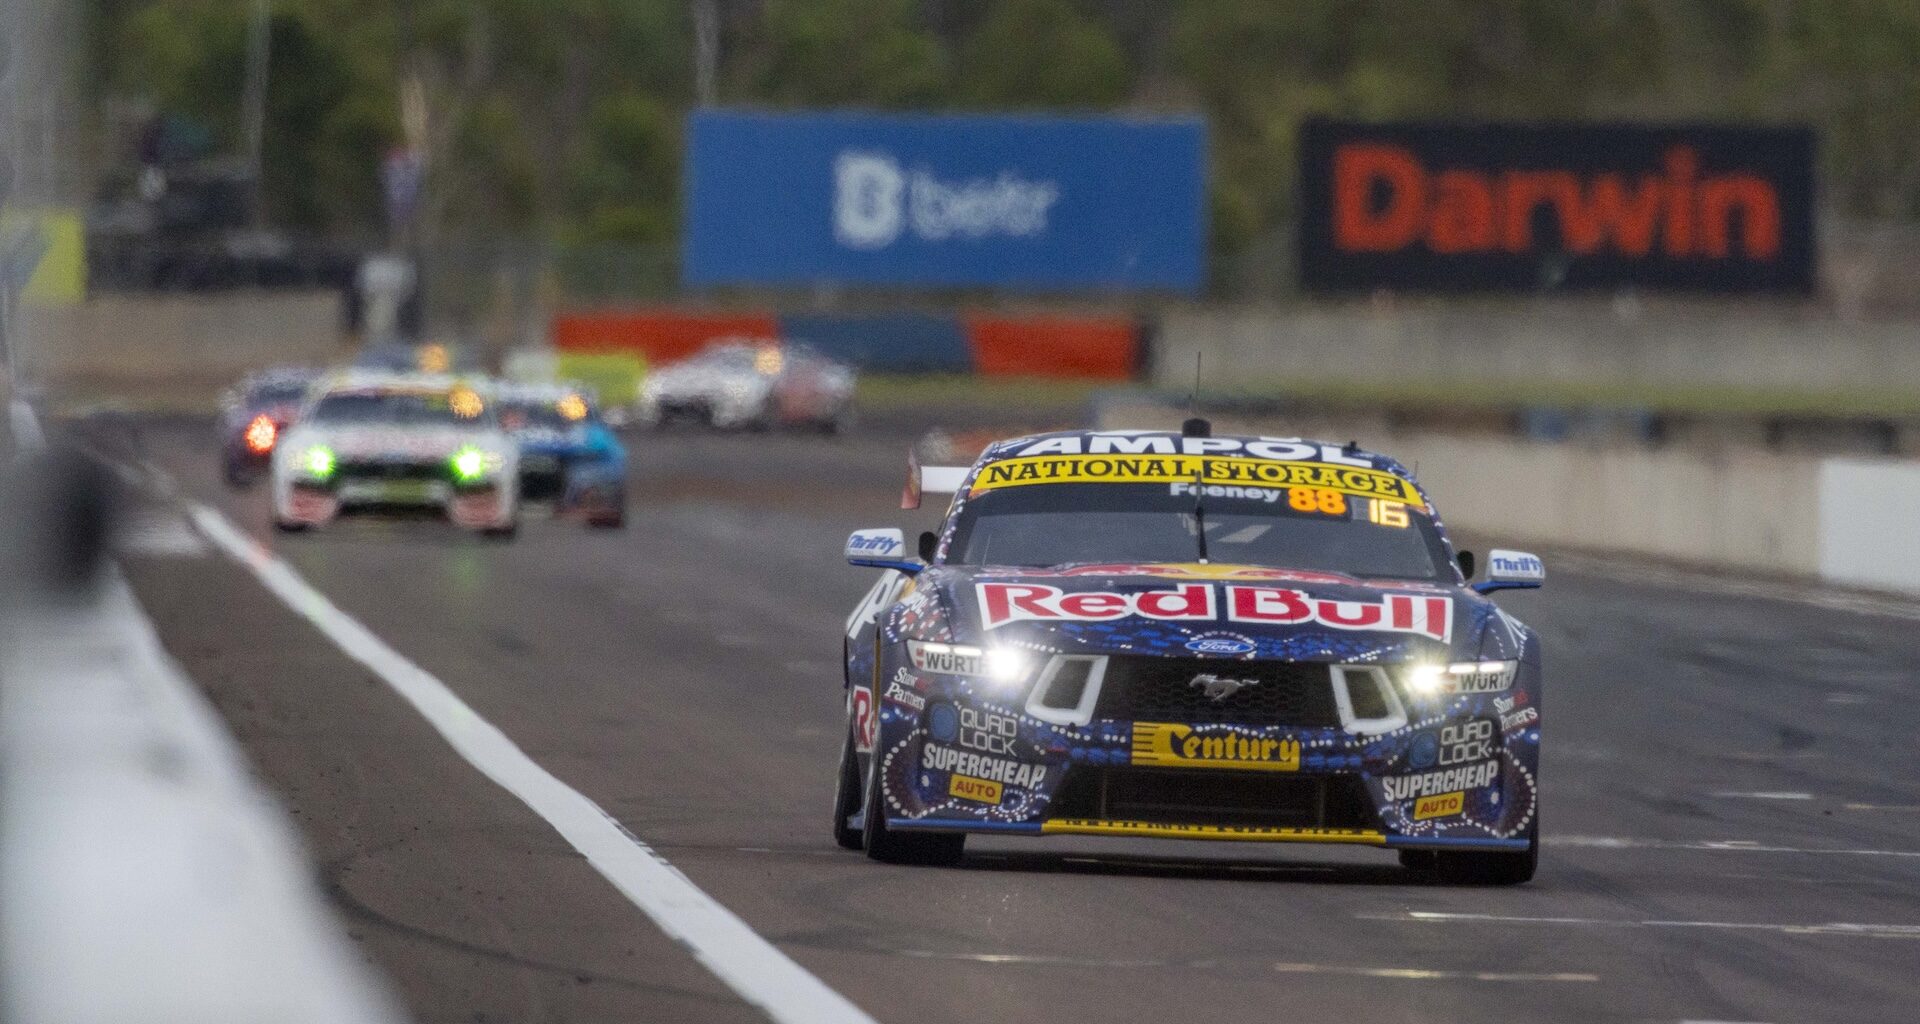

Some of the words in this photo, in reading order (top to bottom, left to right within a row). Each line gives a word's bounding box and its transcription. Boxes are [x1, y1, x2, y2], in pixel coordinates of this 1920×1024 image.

[1333, 142, 1781, 260] Darwin
[1016, 436, 1372, 468] AMPOL
[987, 459, 1196, 484] NATIONAL
[1210, 461, 1399, 497] STORAGE
[1170, 482, 1281, 503] Feeney
[1289, 486, 1346, 515] 88
[975, 583, 1216, 630] Red
[1227, 585, 1453, 644] Bull
[1199, 640, 1241, 652] Ford
[926, 652, 985, 674] WÜRT
[959, 708, 1017, 737] QUAD
[1440, 719, 1492, 746] QUAD
[959, 728, 1017, 756] LOCK
[1170, 723, 1300, 762] Century
[1439, 739, 1493, 765] LOCK
[923, 743, 1047, 790] SUPERCHEAP
[1382, 760, 1499, 802] SUPERCHEAP
[954, 781, 997, 799] AUTO
[1418, 796, 1459, 814] AUTO
